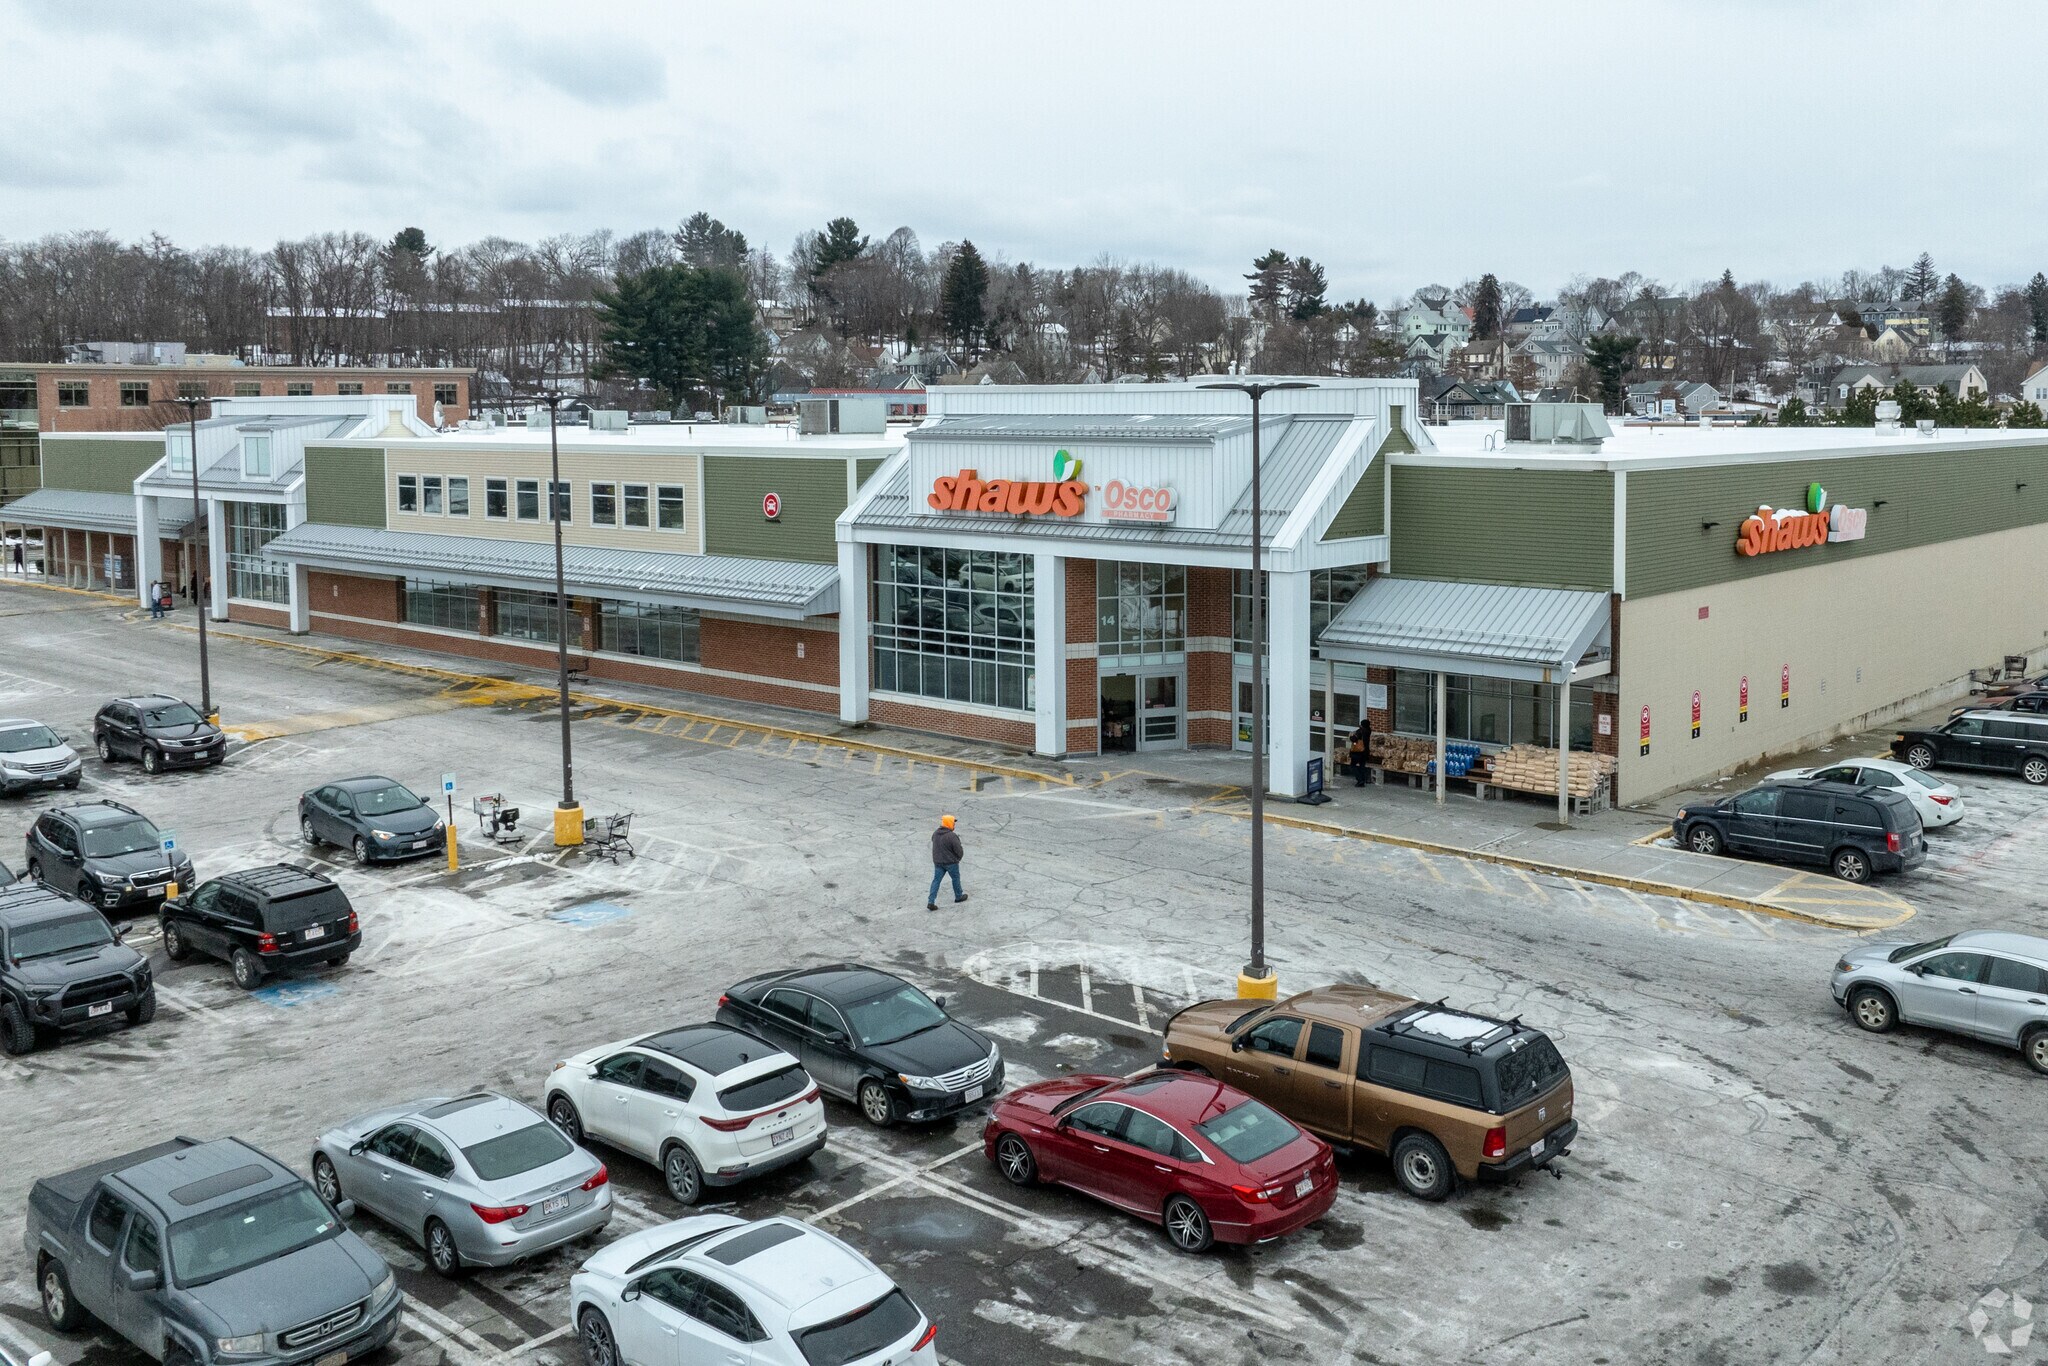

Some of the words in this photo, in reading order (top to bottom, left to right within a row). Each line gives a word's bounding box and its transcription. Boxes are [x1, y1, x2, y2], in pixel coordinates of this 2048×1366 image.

[928, 469, 1088, 517] shaws
[1113, 511, 1154, 519] PHARMACY
[1737, 506, 1829, 556] shaws
[1101, 615, 1115, 625] 14
